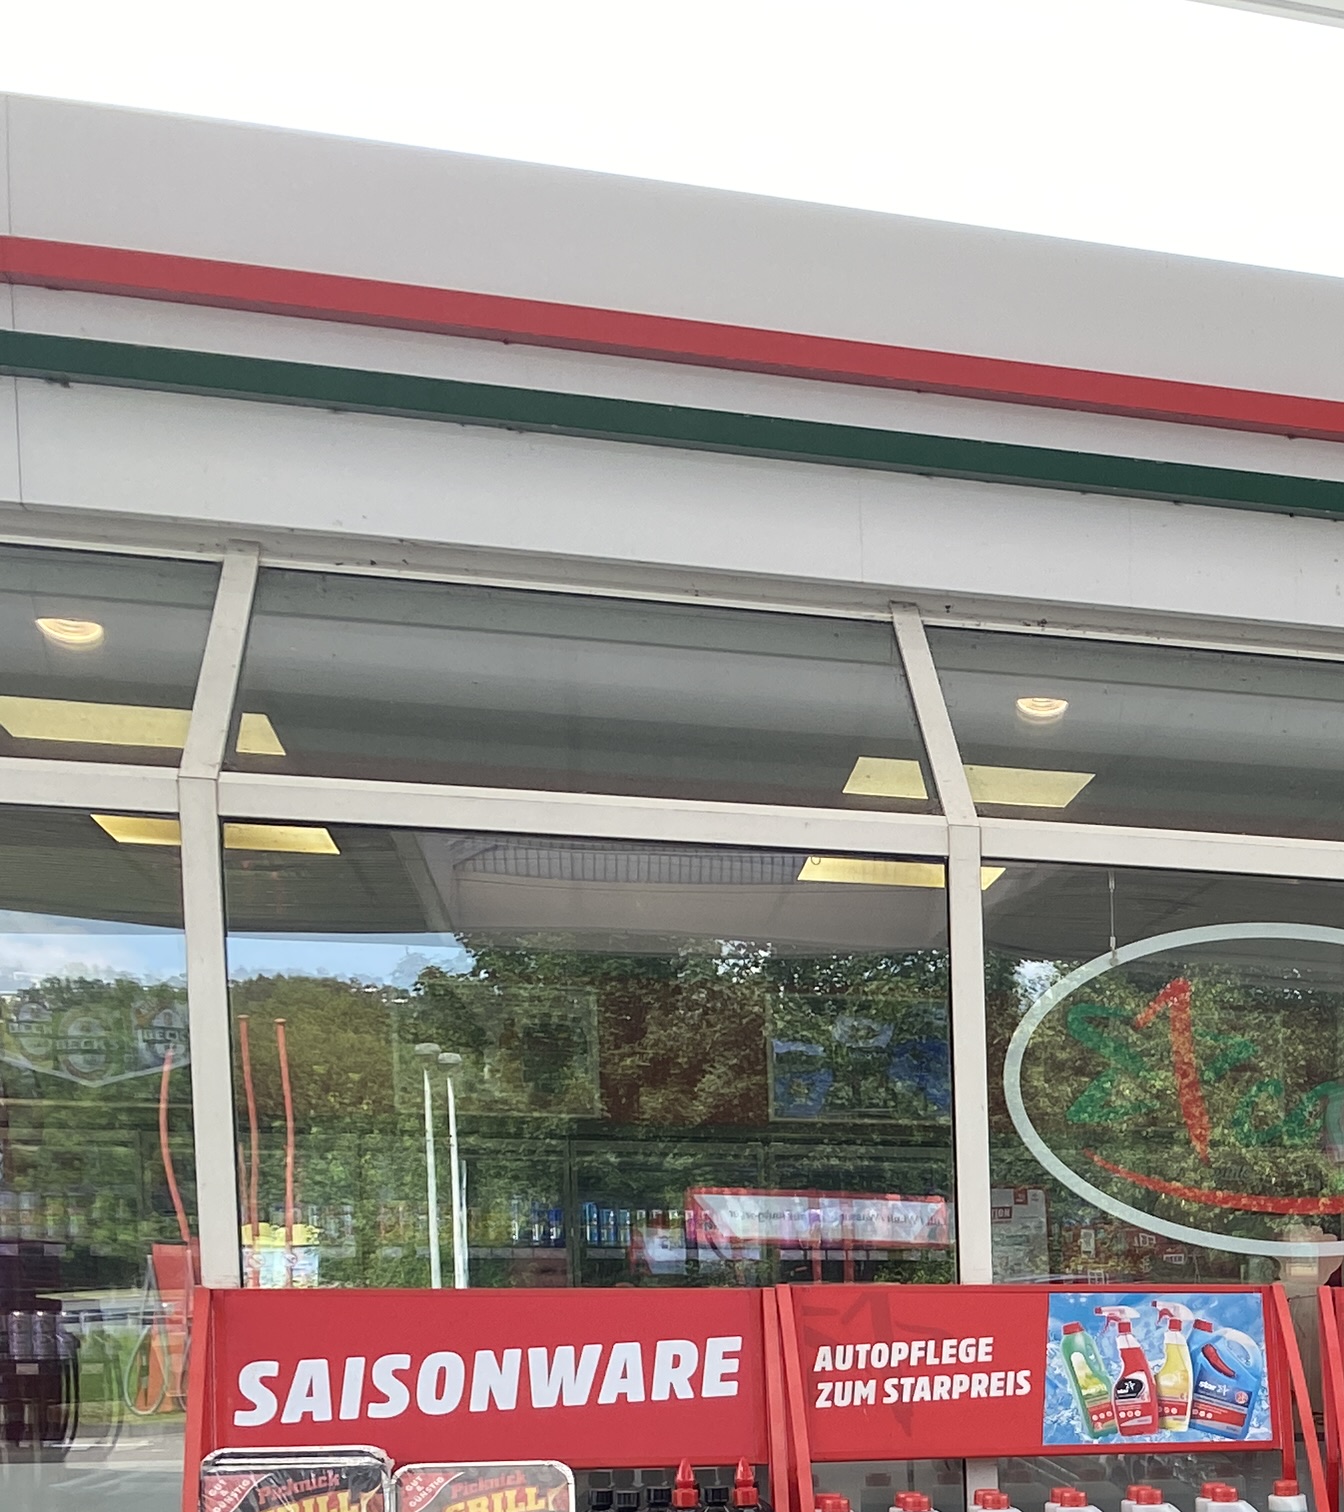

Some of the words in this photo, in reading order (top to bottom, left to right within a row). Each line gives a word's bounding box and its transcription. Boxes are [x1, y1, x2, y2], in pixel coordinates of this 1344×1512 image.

[814, 1337, 994, 1373] AUTOPFLEGE
[233, 1336, 743, 1427] SAISONWARE
[815, 1379, 878, 1408] ZUM
[882, 1369, 1032, 1405] STARPREIS
[1199, 1380, 1217, 1390] star
[208, 1479, 227, 1497] GUT
[257, 1470, 341, 1504] Picknick
[404, 1476, 423, 1492] GUT
[408, 1476, 444, 1508] GÜNSTIG
[450, 1469, 526, 1499] Picknick
